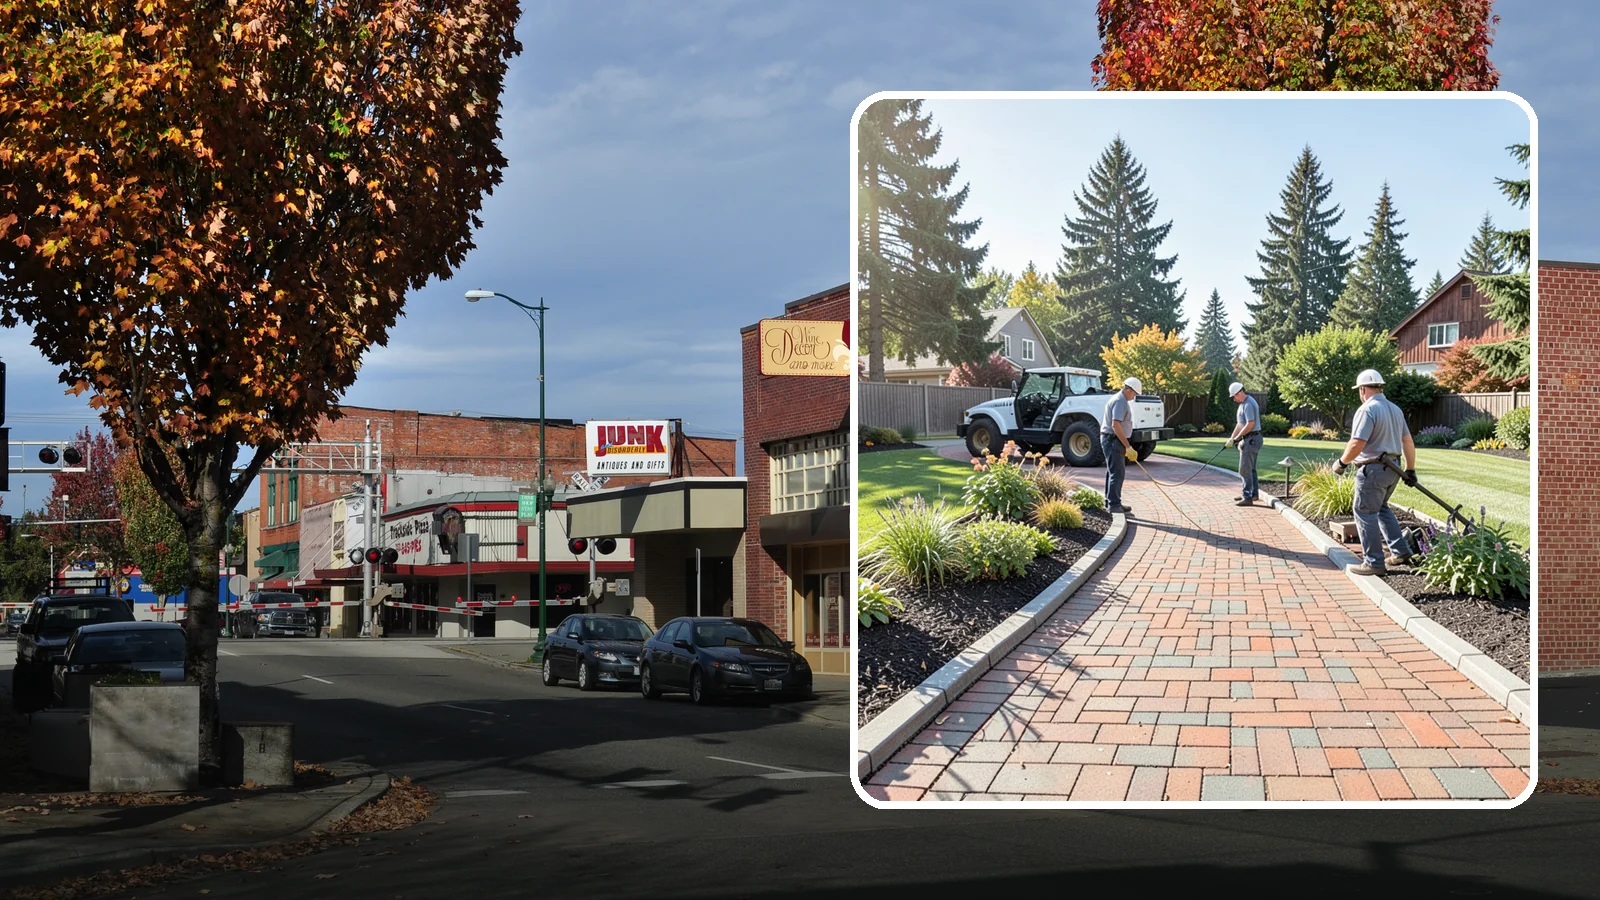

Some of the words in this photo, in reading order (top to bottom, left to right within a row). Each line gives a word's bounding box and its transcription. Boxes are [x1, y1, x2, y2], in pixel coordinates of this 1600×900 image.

[596, 425, 665, 457] JUNK
[607, 446, 646, 454] DISORDERLY
[597, 461, 628, 470] ANTIQUES
[631, 461, 644, 469] AND
[647, 461, 665, 469] GIFTS
[573, 473, 589, 492] RAIL
[415, 519, 429, 535] Pizza
